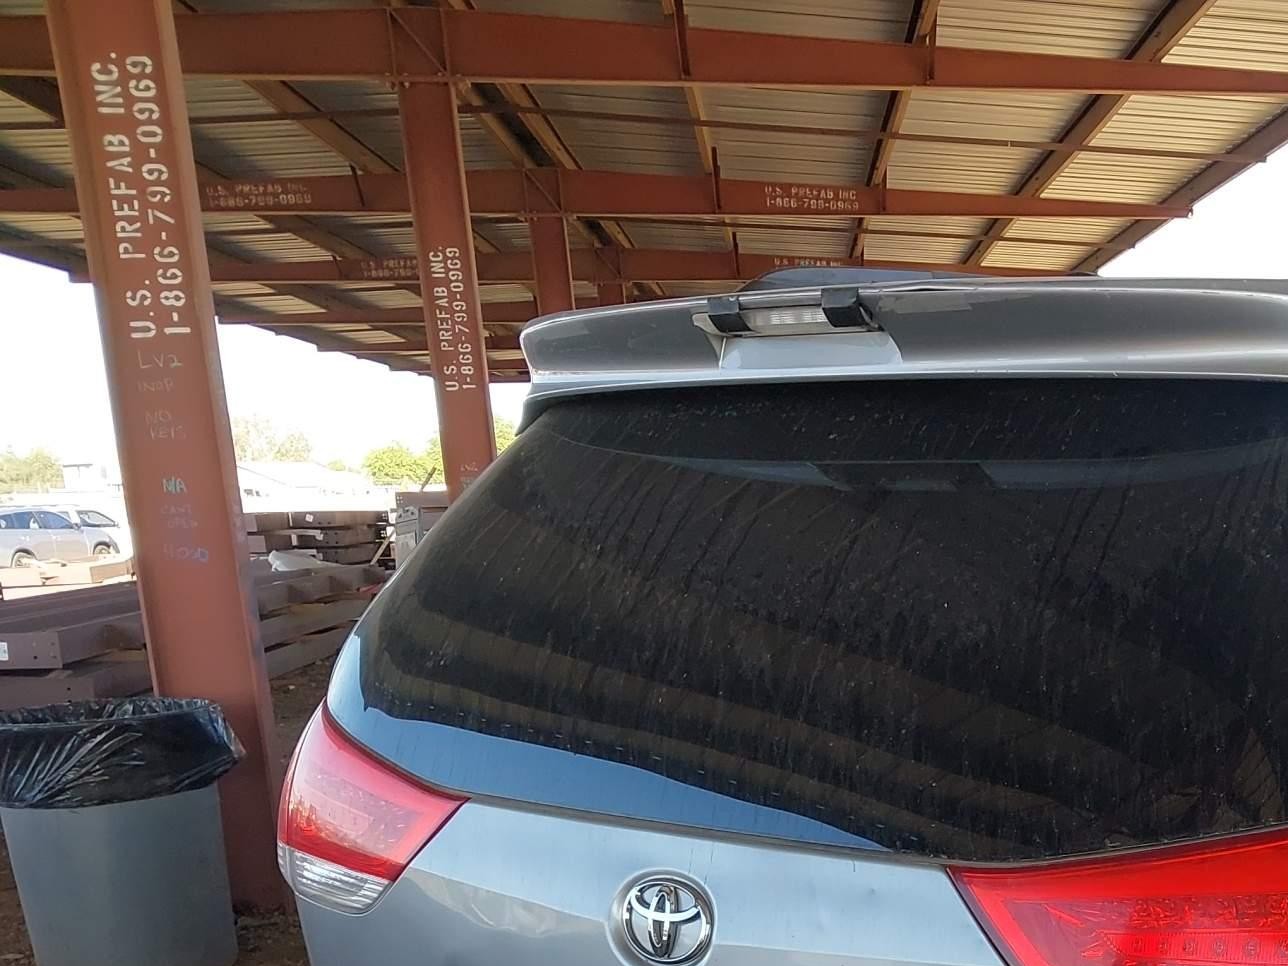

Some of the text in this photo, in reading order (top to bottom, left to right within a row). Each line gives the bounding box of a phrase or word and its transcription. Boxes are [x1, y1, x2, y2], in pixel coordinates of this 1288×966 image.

[90, 52, 157, 339] U.S. PREFAB INC.
[125, 55, 192, 336] 1-866-799-0969
[791, 186, 834, 199] PREFAB
[429, 246, 460, 391] U.S. PREFAB INC.
[446, 247, 477, 390] 1-866-799-0969
